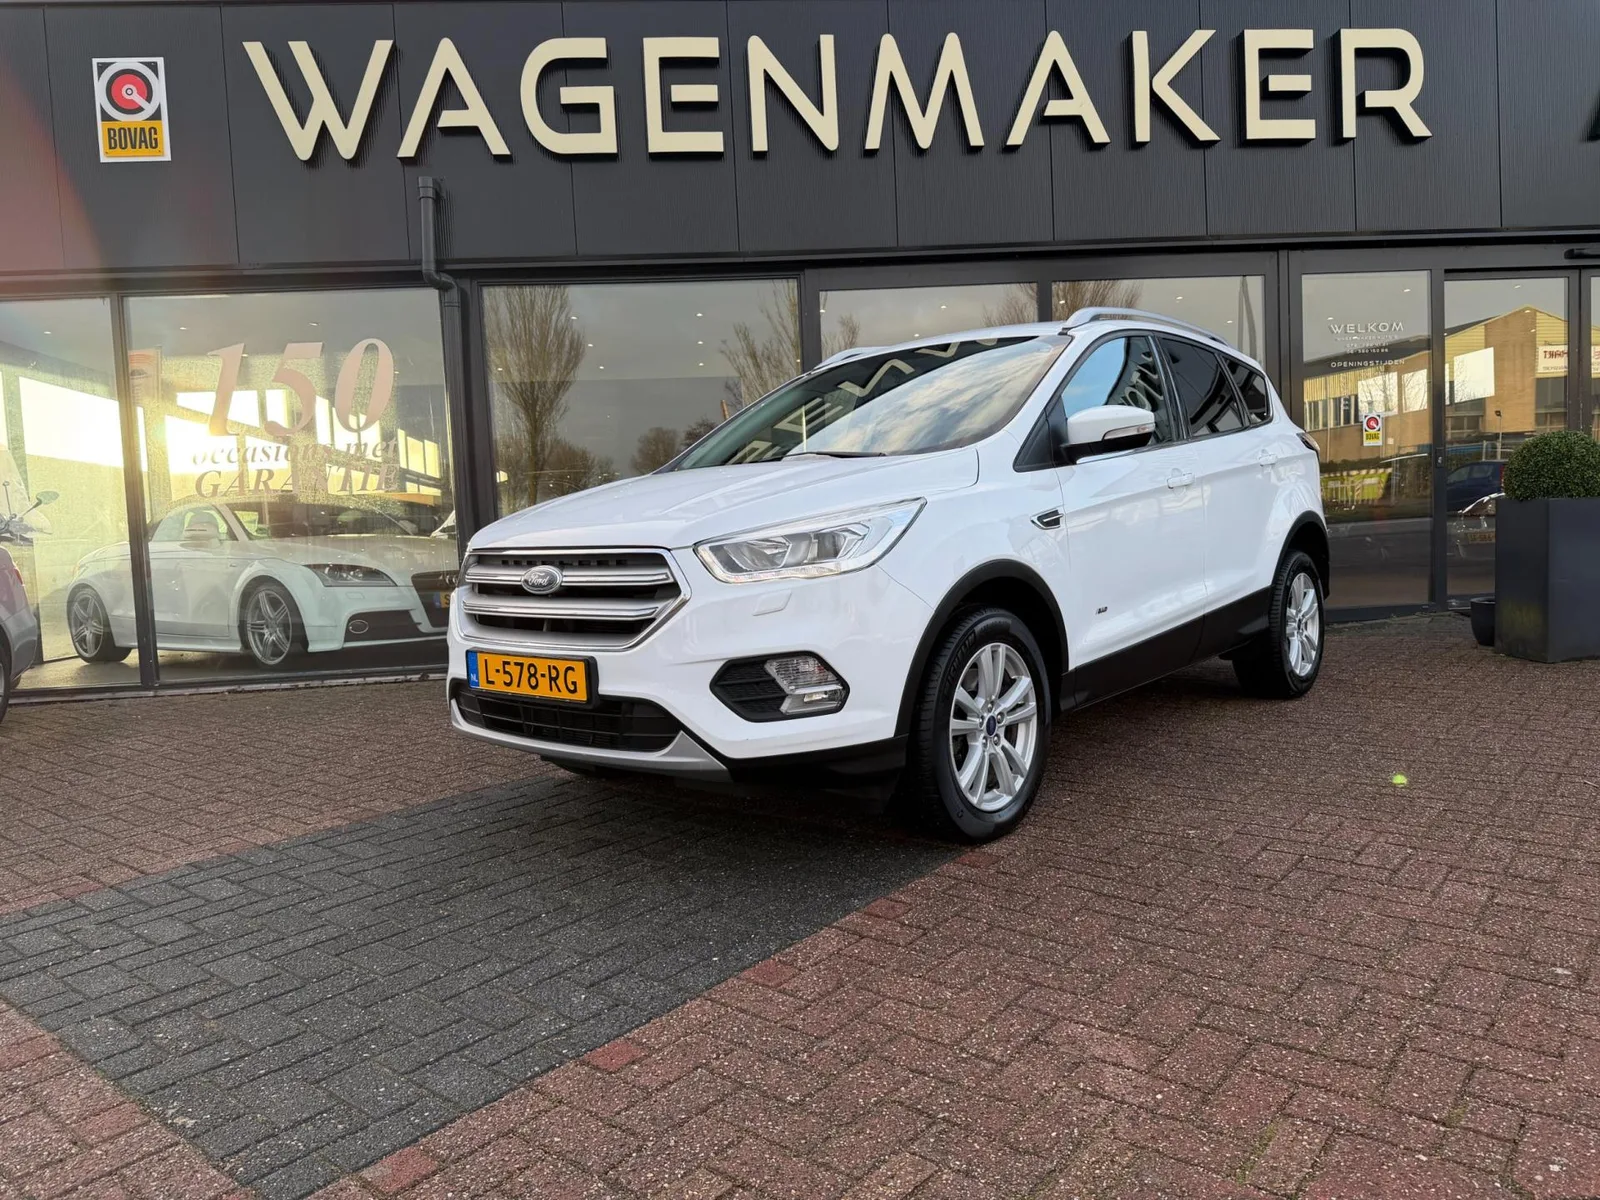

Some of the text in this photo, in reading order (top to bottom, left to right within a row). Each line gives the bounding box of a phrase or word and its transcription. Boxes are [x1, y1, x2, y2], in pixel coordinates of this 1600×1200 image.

[243, 29, 1432, 160] WAGENMAKER
[107, 126, 159, 150] BOVAG
[1330, 321, 1404, 334] WELKOM
[1330, 359, 1405, 368] OPENINGSTIJDEN
[207, 338, 394, 437] 150
[192, 436, 399, 466] occasions met
[195, 463, 401, 499] GARANTIE
[528, 571, 550, 586] Ford
[484, 658, 578, 695] L-578-RG
